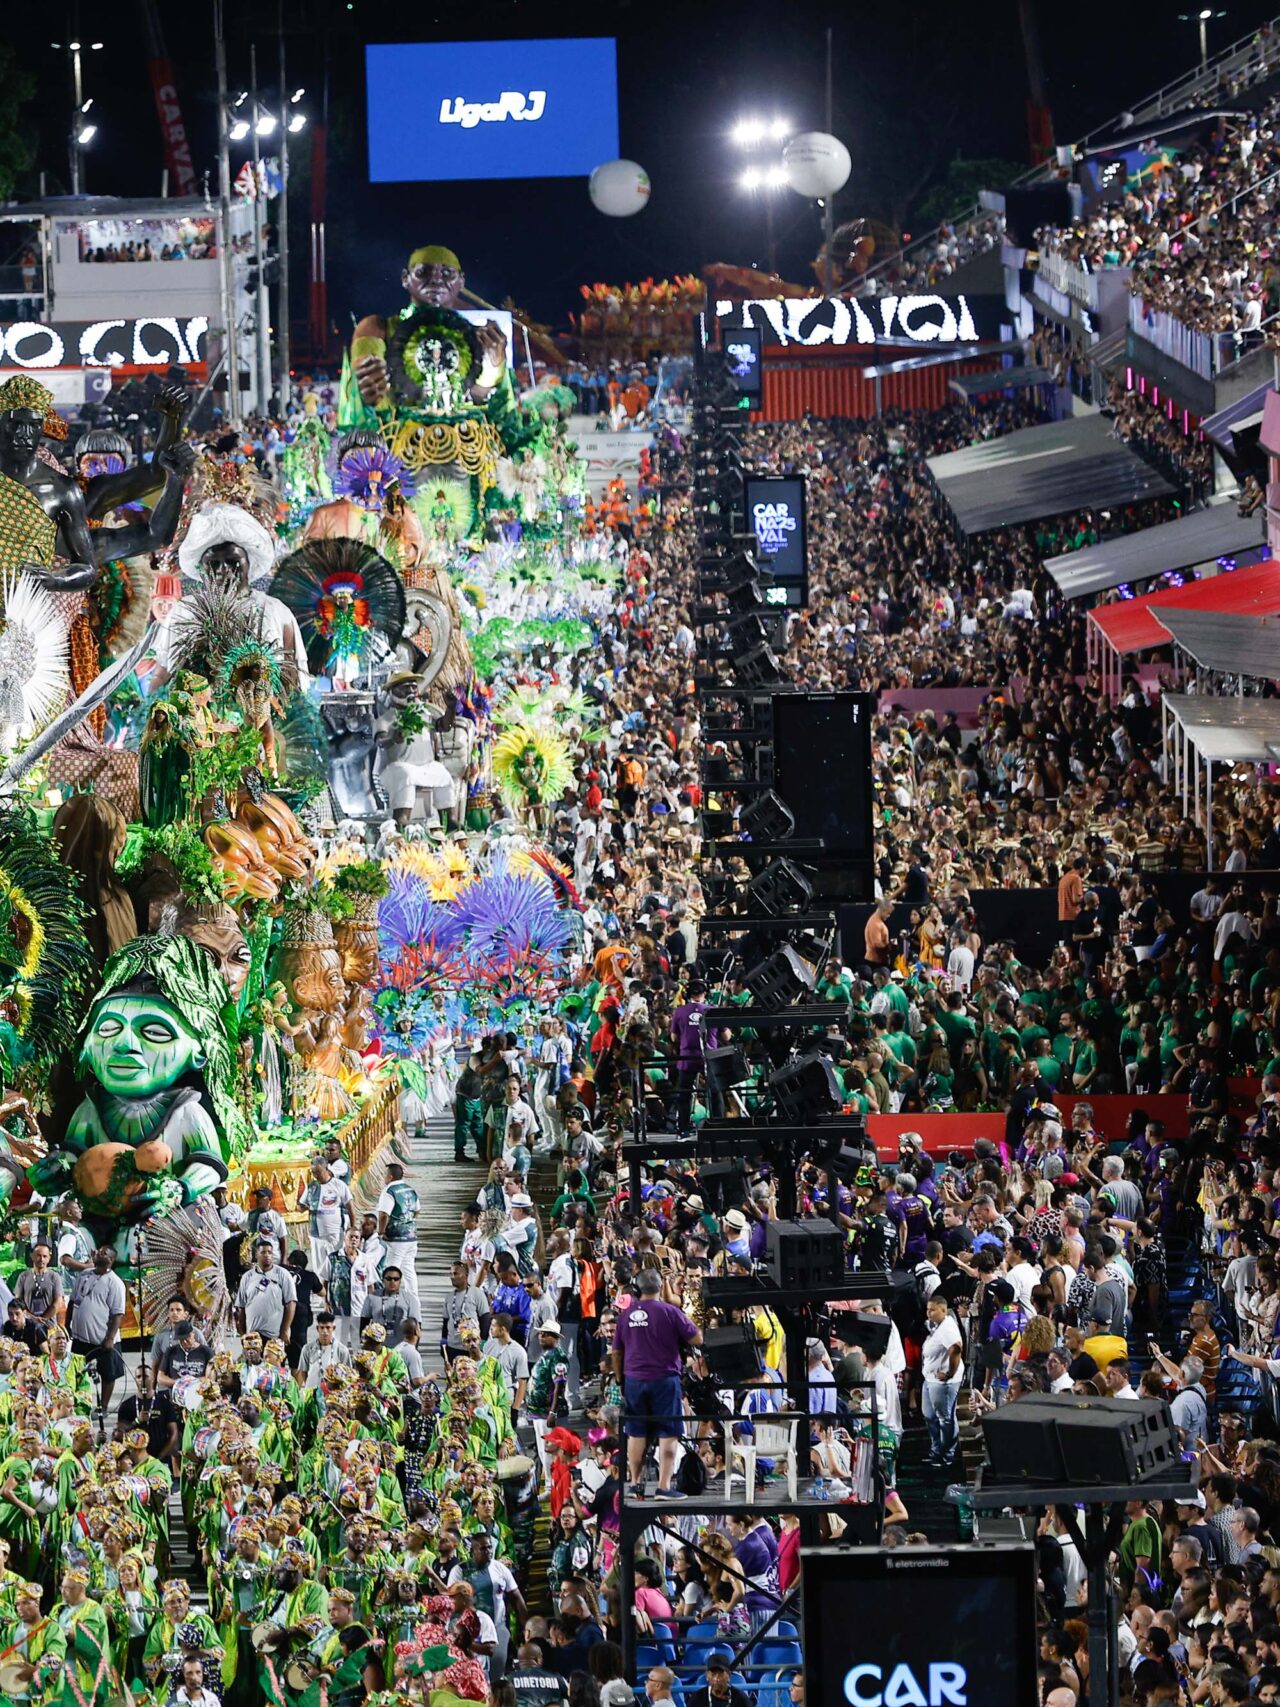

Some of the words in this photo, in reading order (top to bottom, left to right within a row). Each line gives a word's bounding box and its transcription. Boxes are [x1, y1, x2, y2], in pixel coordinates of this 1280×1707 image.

[439, 90, 546, 128] LigaRJ
[160, 84, 197, 198] CARVA
[753, 503, 789, 518] CAR
[513, 1676, 560, 1690] DIRETORIA
[843, 1661, 968, 1707] CAR
